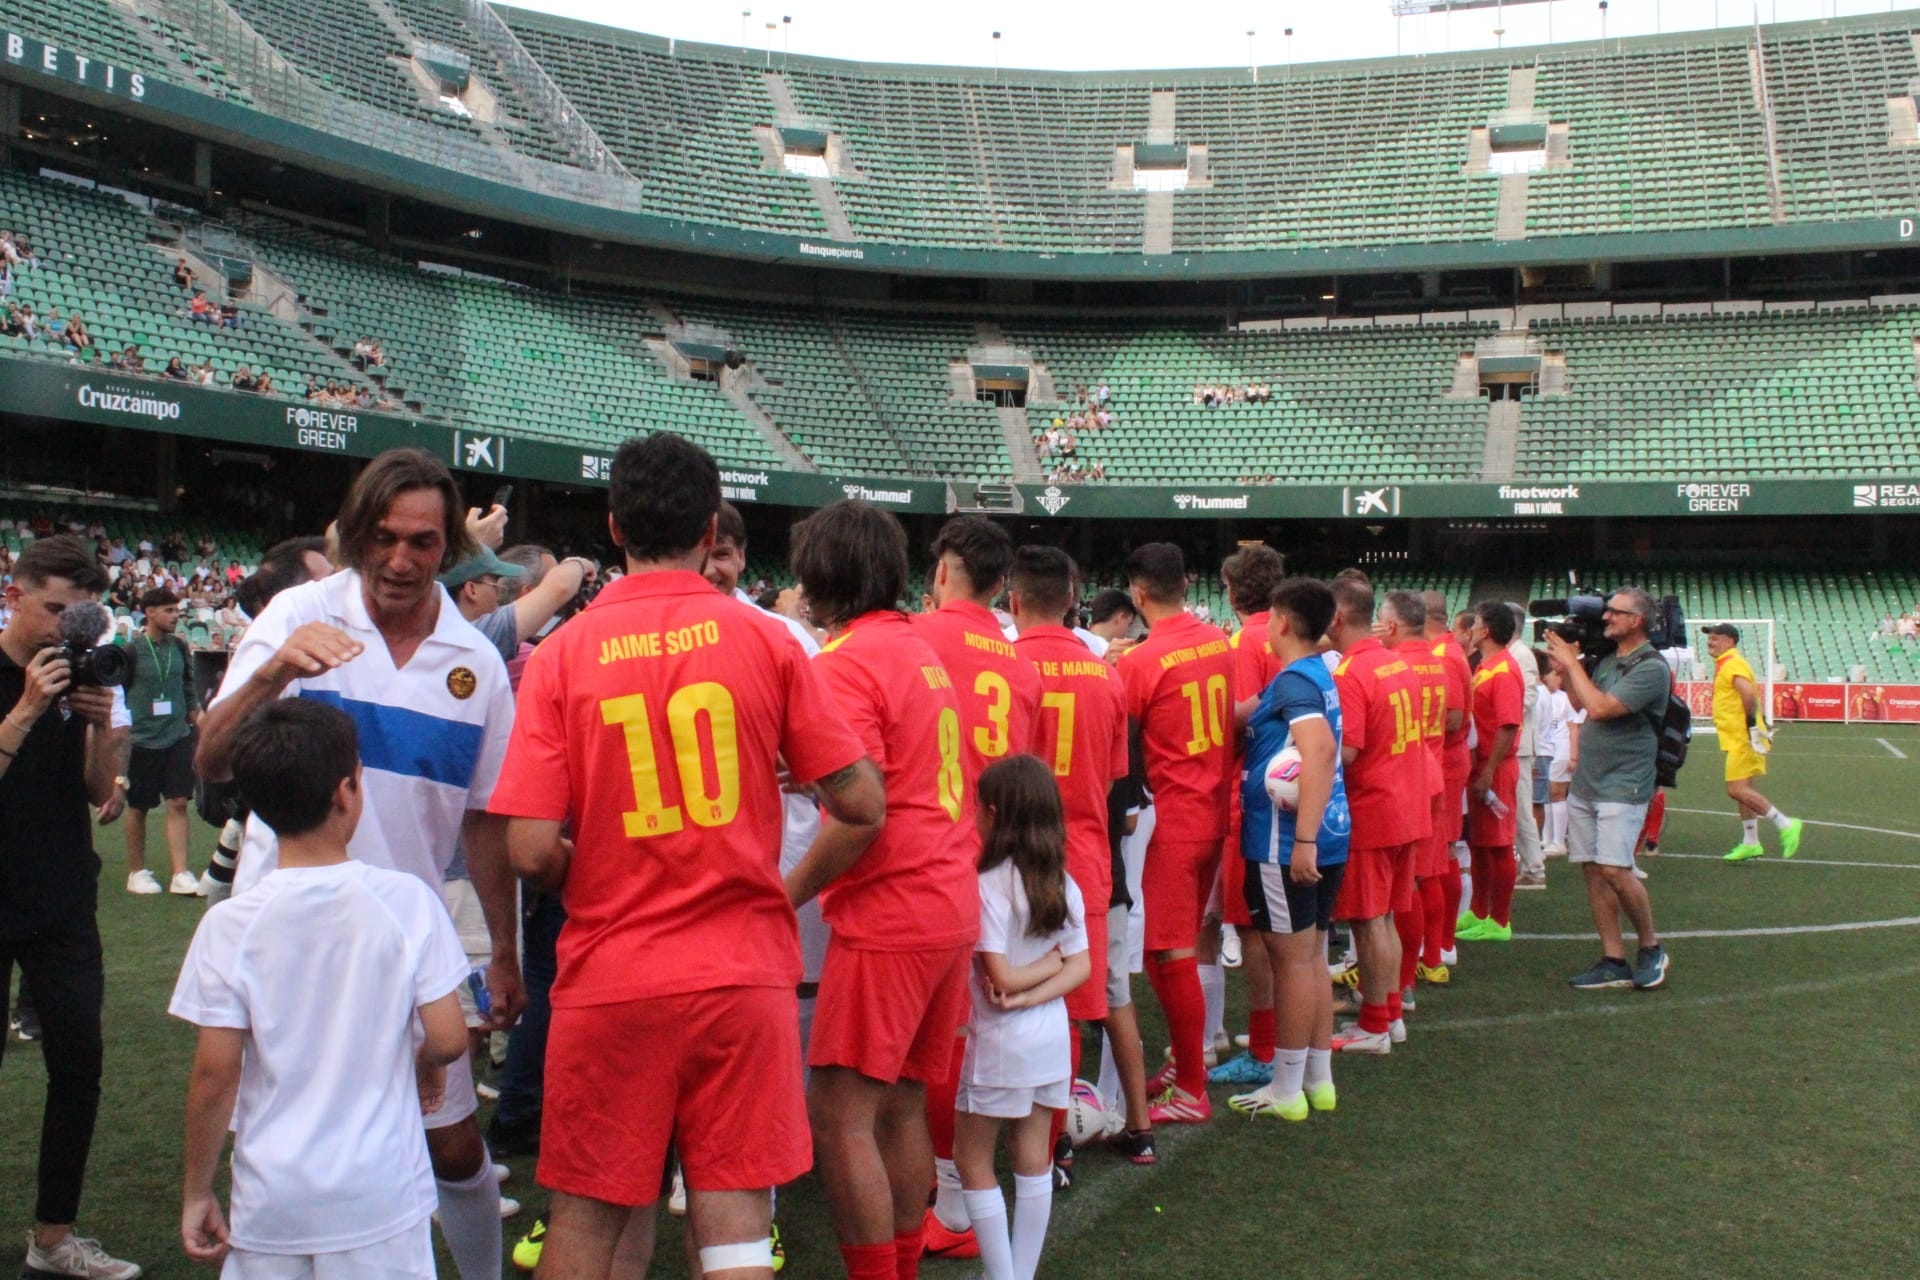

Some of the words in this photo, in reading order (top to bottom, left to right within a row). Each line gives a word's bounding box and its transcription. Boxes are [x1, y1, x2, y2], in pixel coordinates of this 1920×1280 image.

[7, 33, 145, 97] BETIS
[1900, 219, 1913, 237] D
[800, 242, 864, 260] Manquepierda
[78, 384, 180, 420] Cruzcampo
[286, 407, 358, 433] FOREVER
[298, 429, 346, 449] GREEN
[718, 470, 769, 485] network
[861, 486, 912, 503] hummel
[1191, 495, 1248, 509] hummel
[1498, 484, 1579, 499] finetwork
[1677, 483, 1750, 498] FOREVER
[1689, 498, 1739, 512] GREEN
[598, 632, 663, 665] JAIME
[665, 619, 720, 656] SOTO
[964, 631, 1017, 660] MONTOYA
[1042, 661, 1060, 677] DE
[1062, 661, 1109, 680] MANUEL
[973, 670, 1011, 757] 3
[1181, 673, 1227, 756] 10
[1041, 691, 1076, 777] 7
[600, 681, 740, 838] 10
[937, 707, 964, 824] 8
